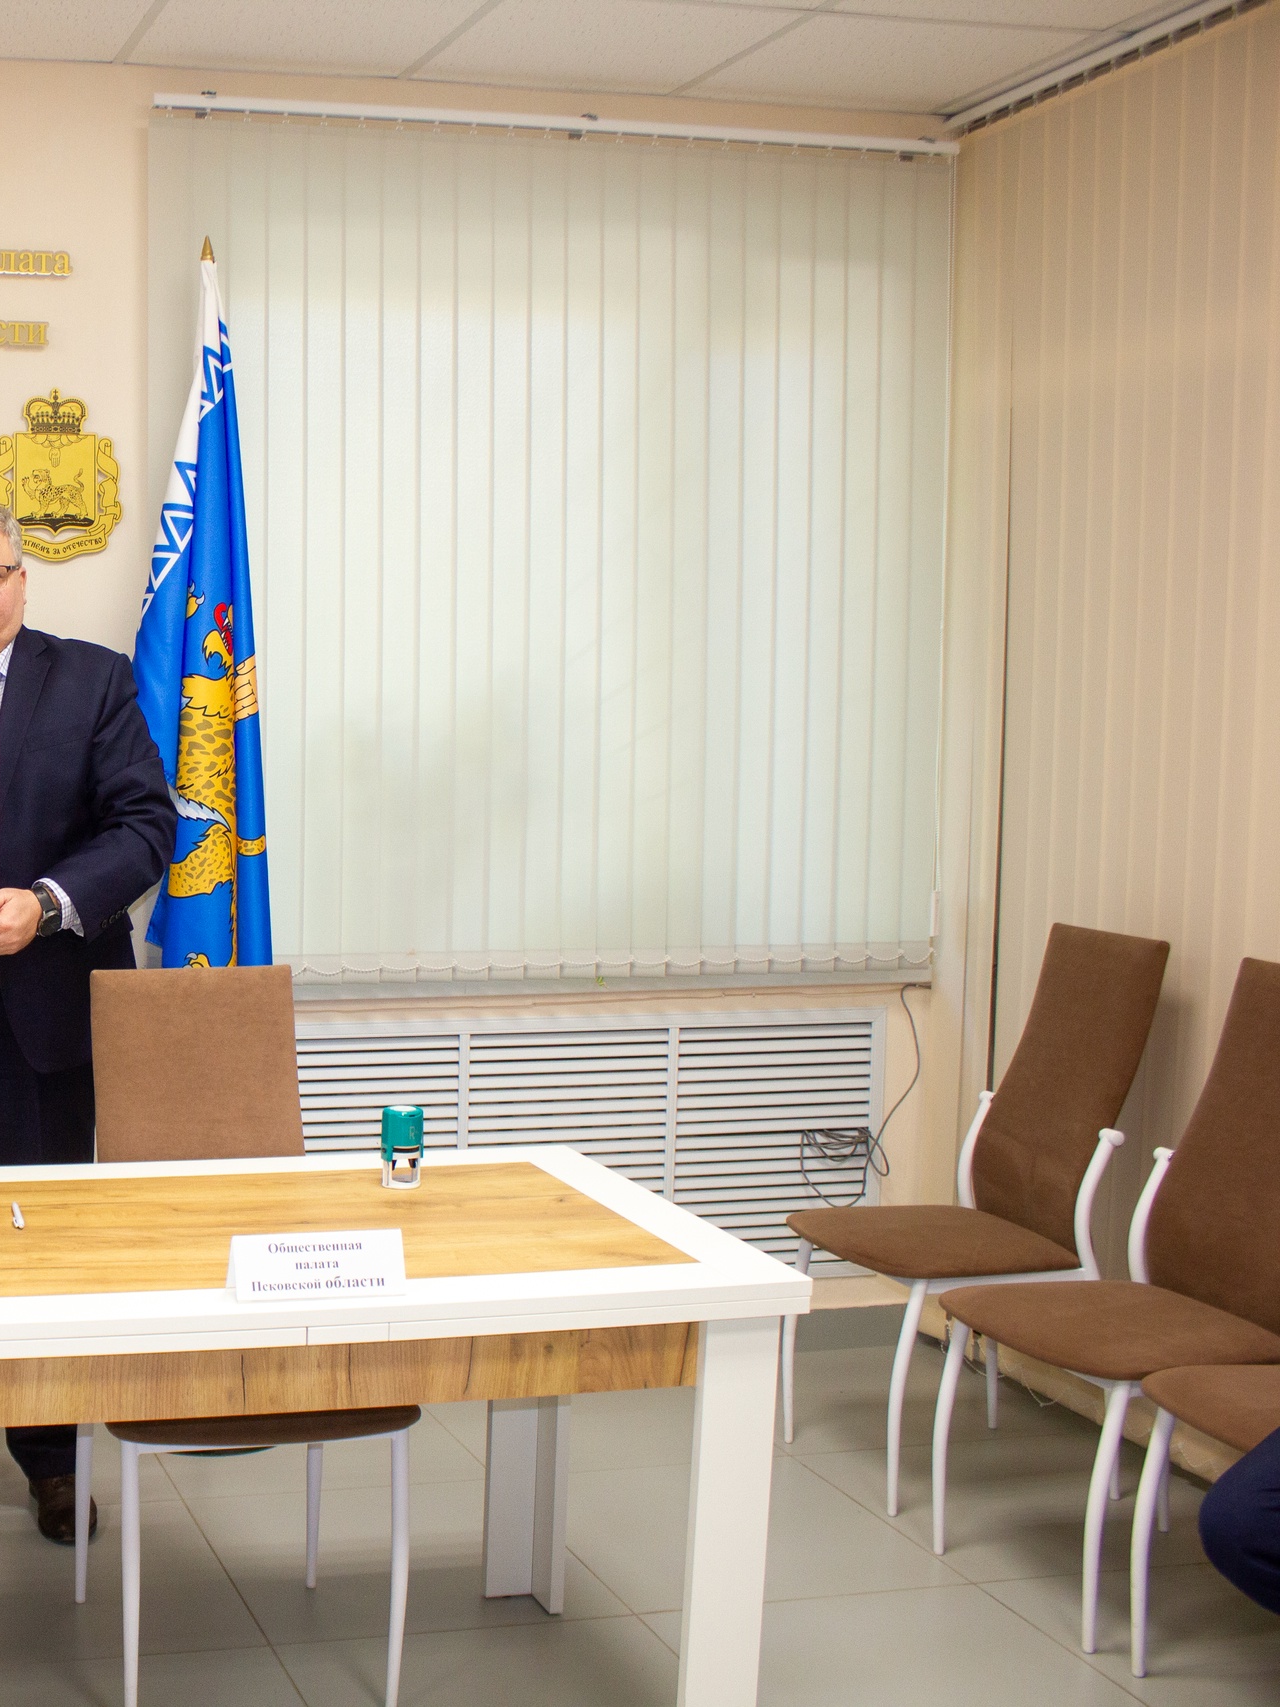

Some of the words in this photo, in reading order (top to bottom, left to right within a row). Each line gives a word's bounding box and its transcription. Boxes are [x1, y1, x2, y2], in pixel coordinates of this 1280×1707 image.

[268, 1242, 362, 1254] Общественная
[295, 1260, 339, 1270] палата
[252, 1278, 321, 1292] Псковской
[325, 1276, 385, 1289] области
